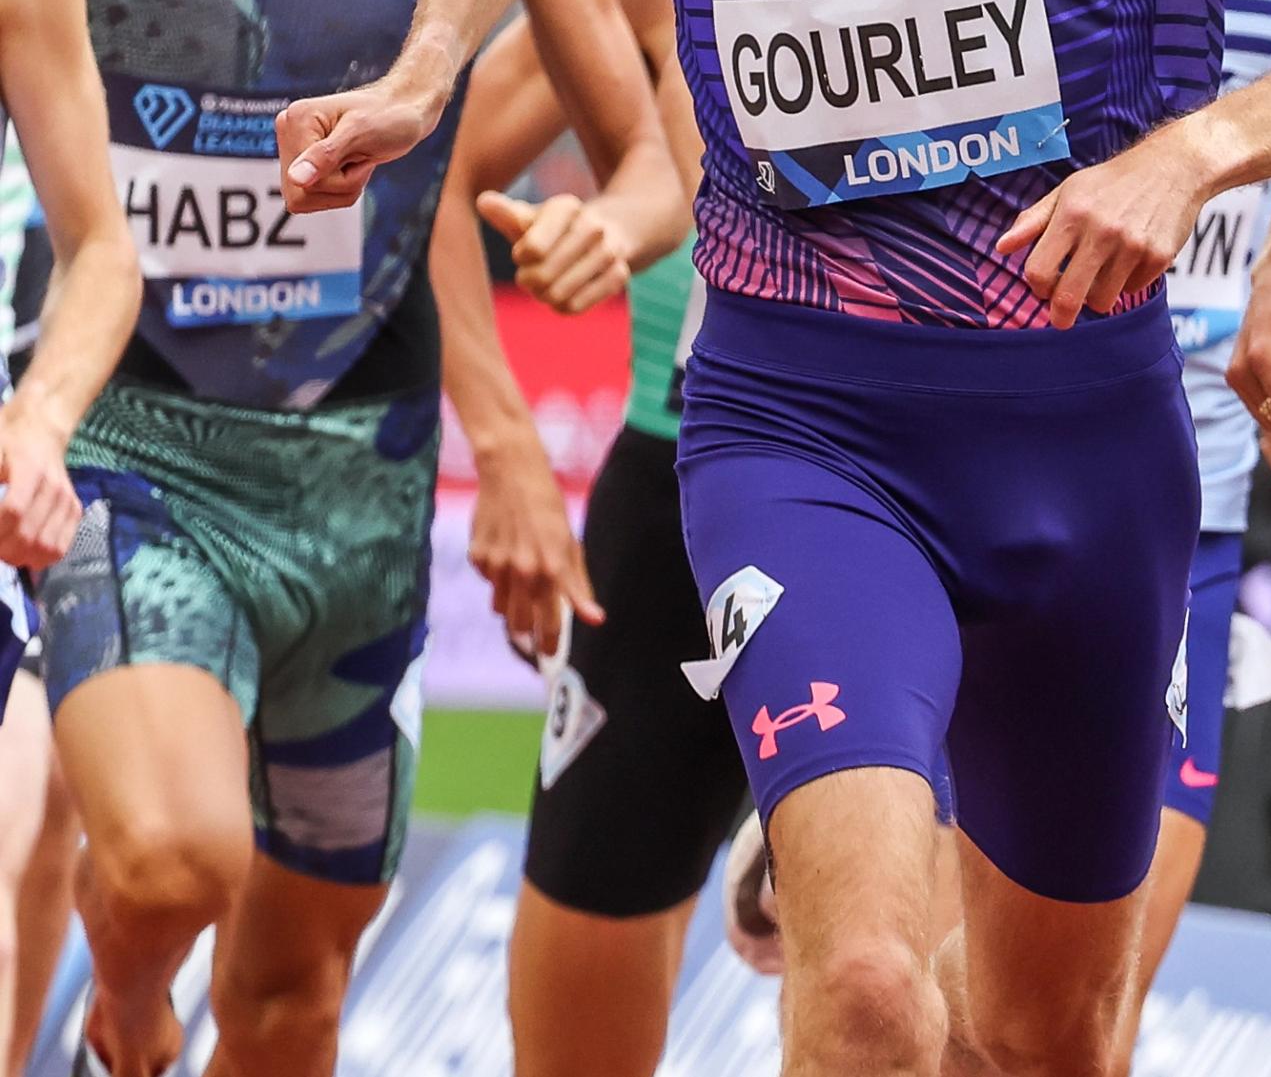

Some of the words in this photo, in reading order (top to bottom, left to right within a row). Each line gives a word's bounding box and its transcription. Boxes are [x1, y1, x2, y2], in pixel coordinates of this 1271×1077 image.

[843, 127, 1020, 186] LONDON
[126, 179, 306, 249] HABZ
[171, 279, 321, 317] LONDON
